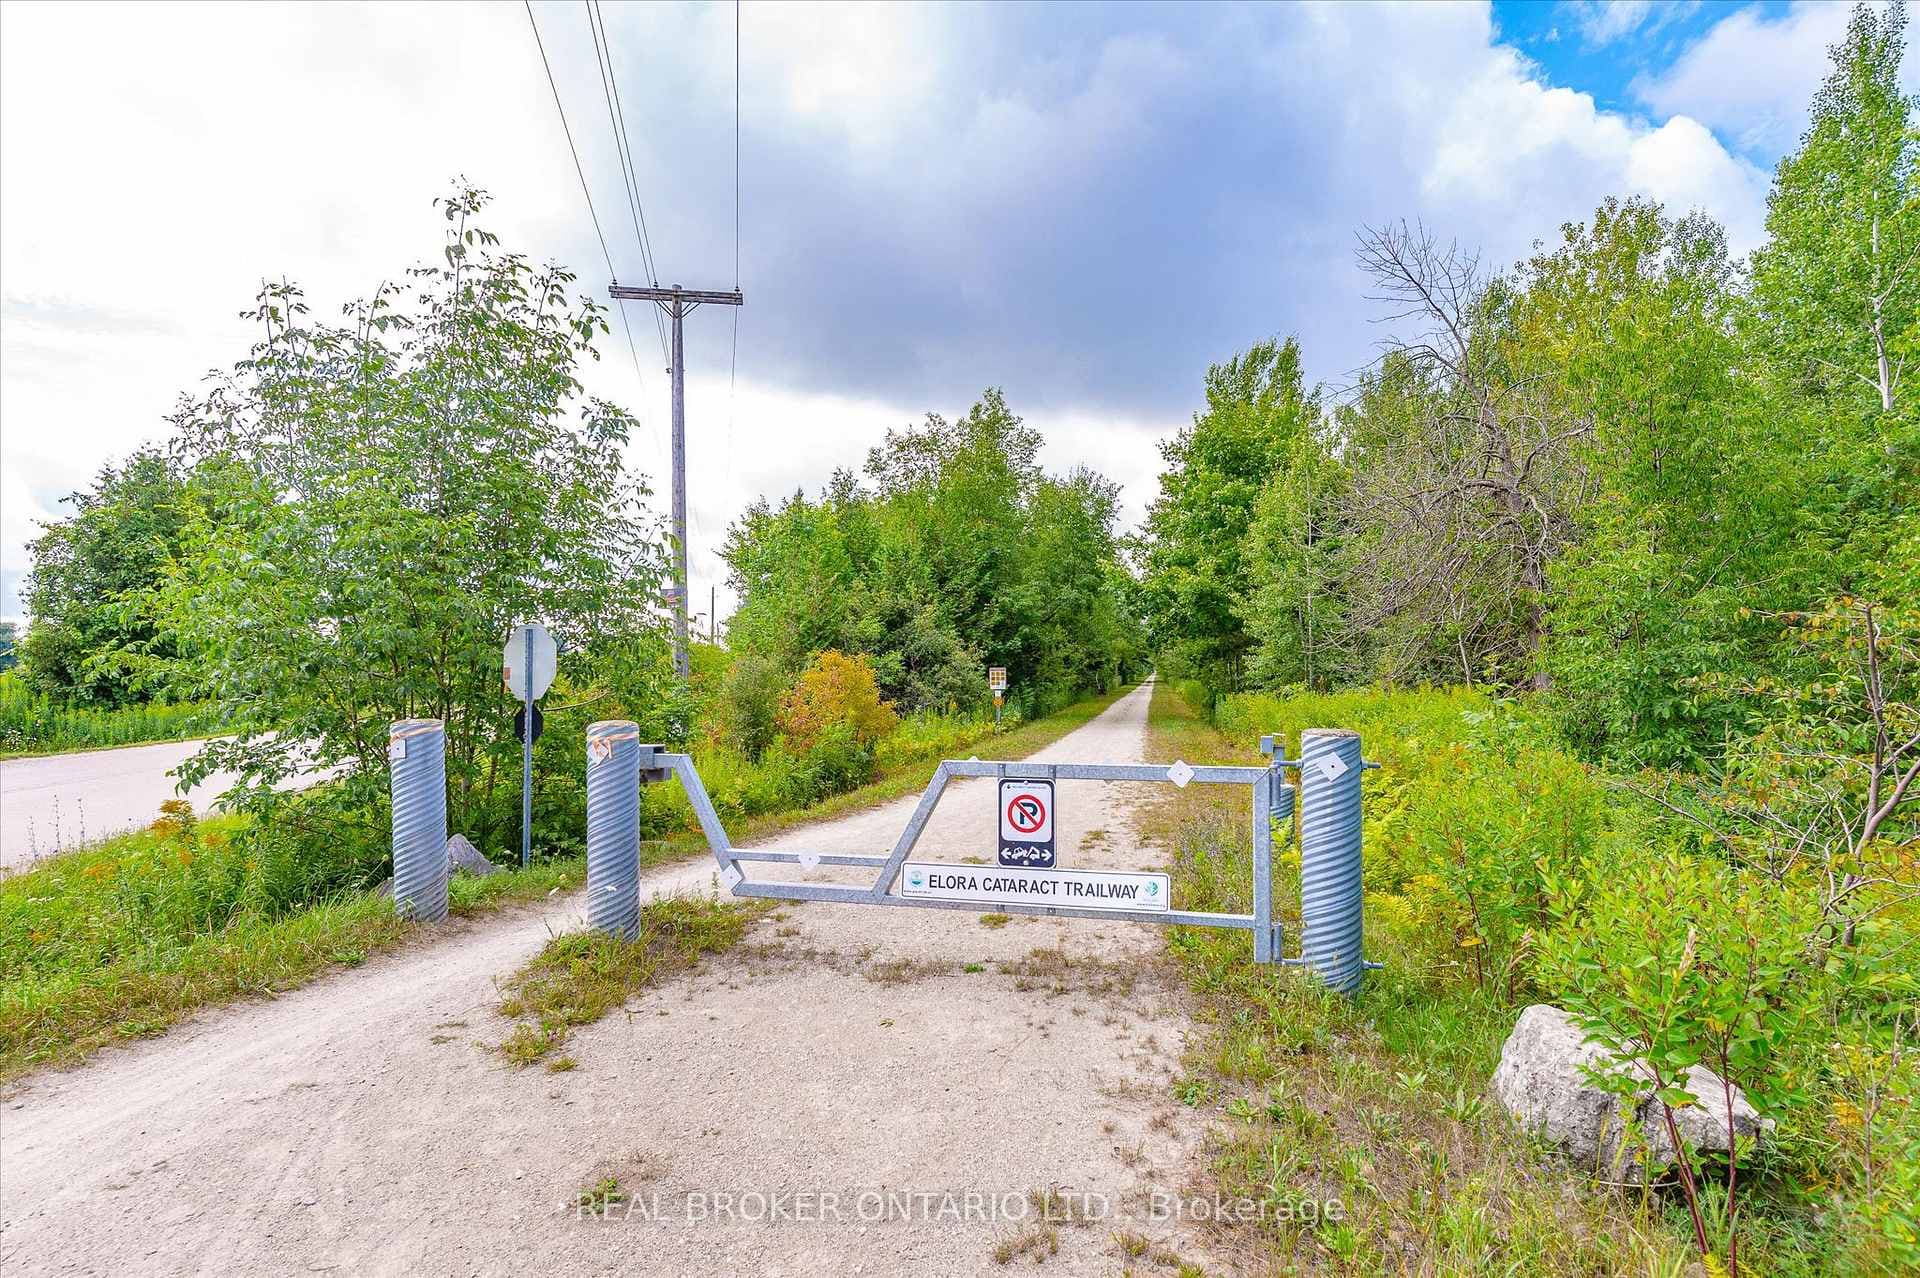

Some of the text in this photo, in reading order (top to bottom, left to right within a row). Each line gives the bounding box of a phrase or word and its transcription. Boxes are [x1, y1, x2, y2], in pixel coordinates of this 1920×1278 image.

[928, 874, 1140, 899] ELORA CATARACT TRAILWAY
